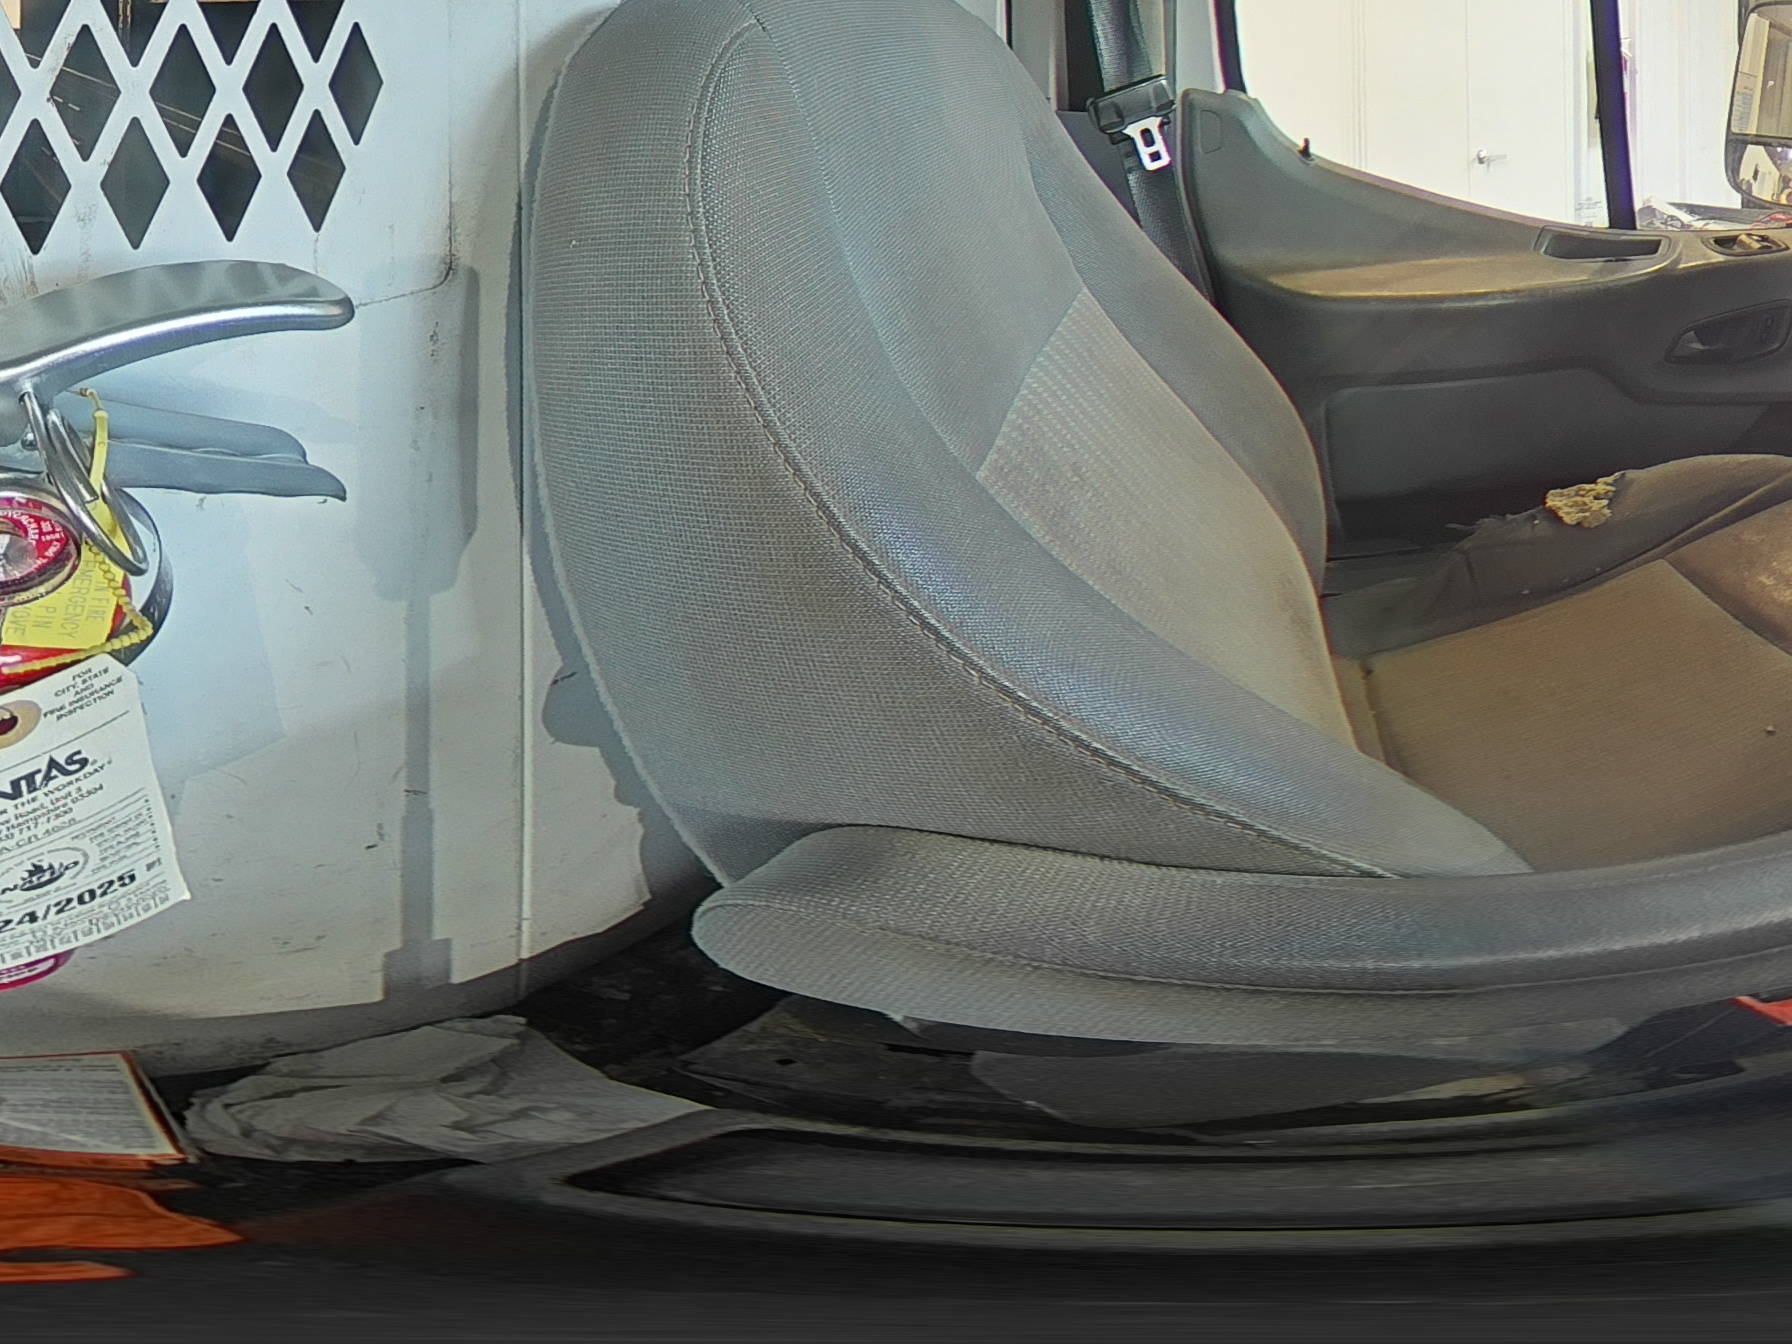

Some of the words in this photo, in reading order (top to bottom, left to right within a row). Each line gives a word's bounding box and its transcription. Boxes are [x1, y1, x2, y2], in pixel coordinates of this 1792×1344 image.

[57, 559, 99, 639] EMERGENCY
[86, 597, 110, 623] FIRE
[32, 605, 56, 629] PIN
[14, 797, 39, 810] THE
